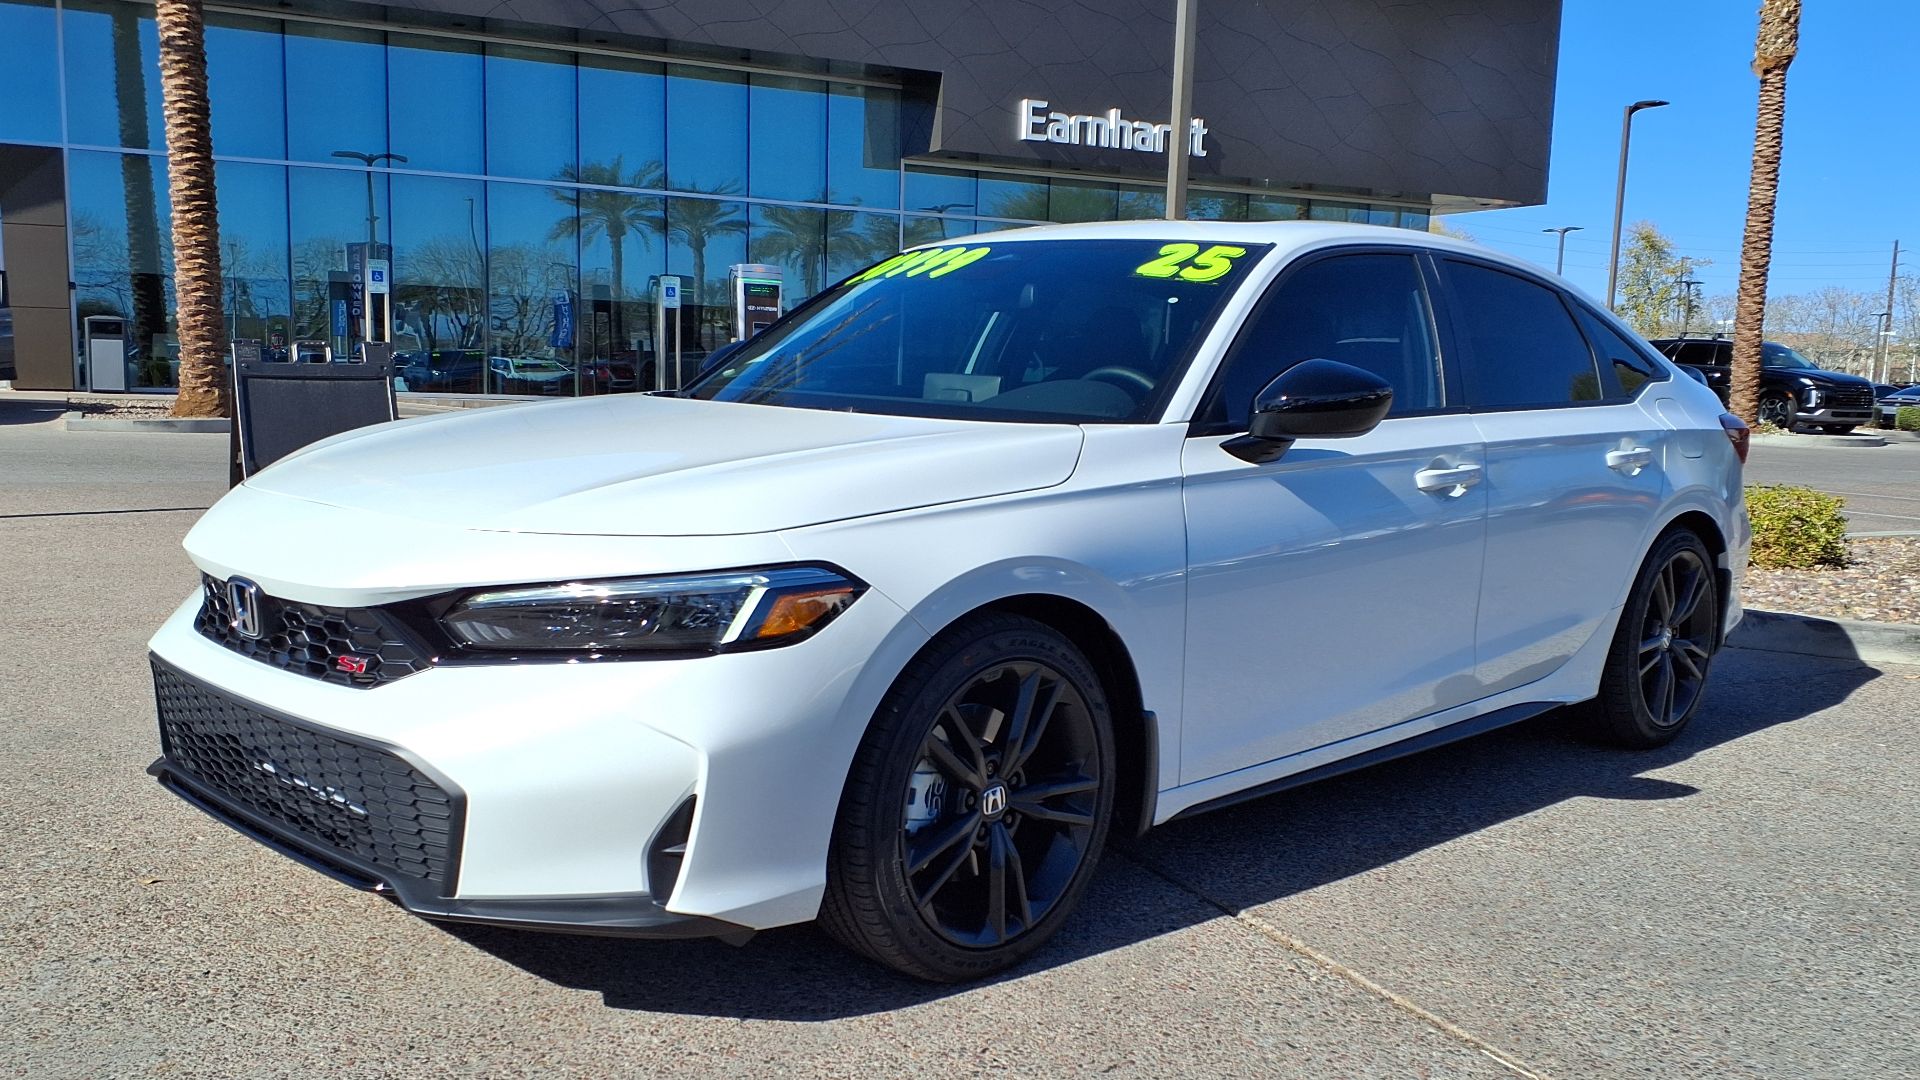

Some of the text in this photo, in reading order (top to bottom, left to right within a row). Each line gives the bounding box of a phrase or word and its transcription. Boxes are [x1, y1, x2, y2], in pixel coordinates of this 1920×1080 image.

[1020, 98, 1208, 157] Earnhart
[1136, 243, 1247, 282] 25
[336, 655, 368, 673] Si
